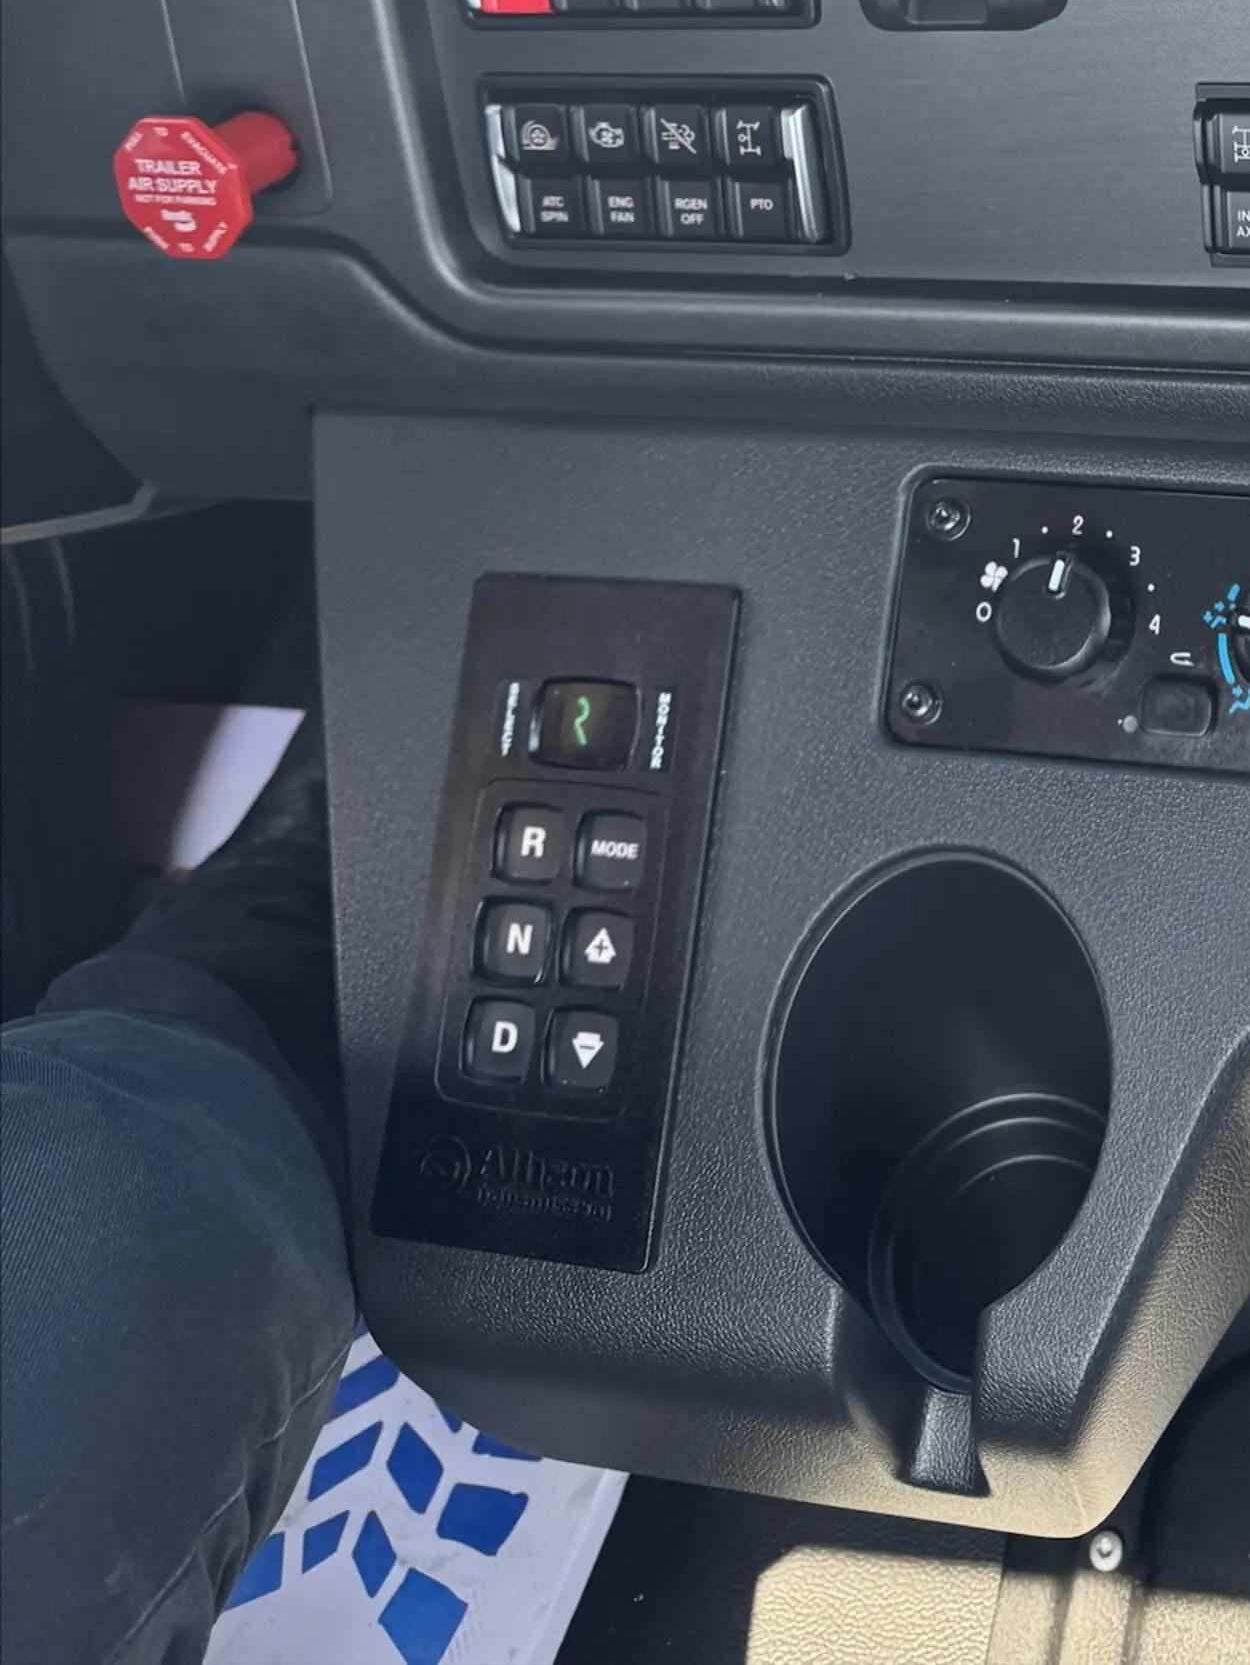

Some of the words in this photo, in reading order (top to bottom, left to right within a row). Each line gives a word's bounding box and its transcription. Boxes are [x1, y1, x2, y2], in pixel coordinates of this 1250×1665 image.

[133, 158, 202, 175] TRAILER
[128, 177, 154, 192] AIR
[155, 178, 218, 194] SUPPLY
[542, 196, 565, 209] ATC
[608, 197, 634, 209] ENG
[674, 198, 708, 210] RGEN
[750, 198, 773, 211] PTO
[541, 211, 569, 223] SPIN
[610, 211, 635, 223] FAN
[681, 213, 704, 225] OFF
[1072, 515, 1085, 535] 2
[1012, 538, 1021, 558] 1
[1129, 546, 1141, 565] 3
[975, 602, 992, 622] 0
[1149, 614, 1161, 635] 4
[650, 692, 672, 769] MONITOR
[521, 826, 547, 858] R
[590, 839, 640, 860] MODE
[506, 923, 533, 956] N
[491, 1020, 519, 1054] D
